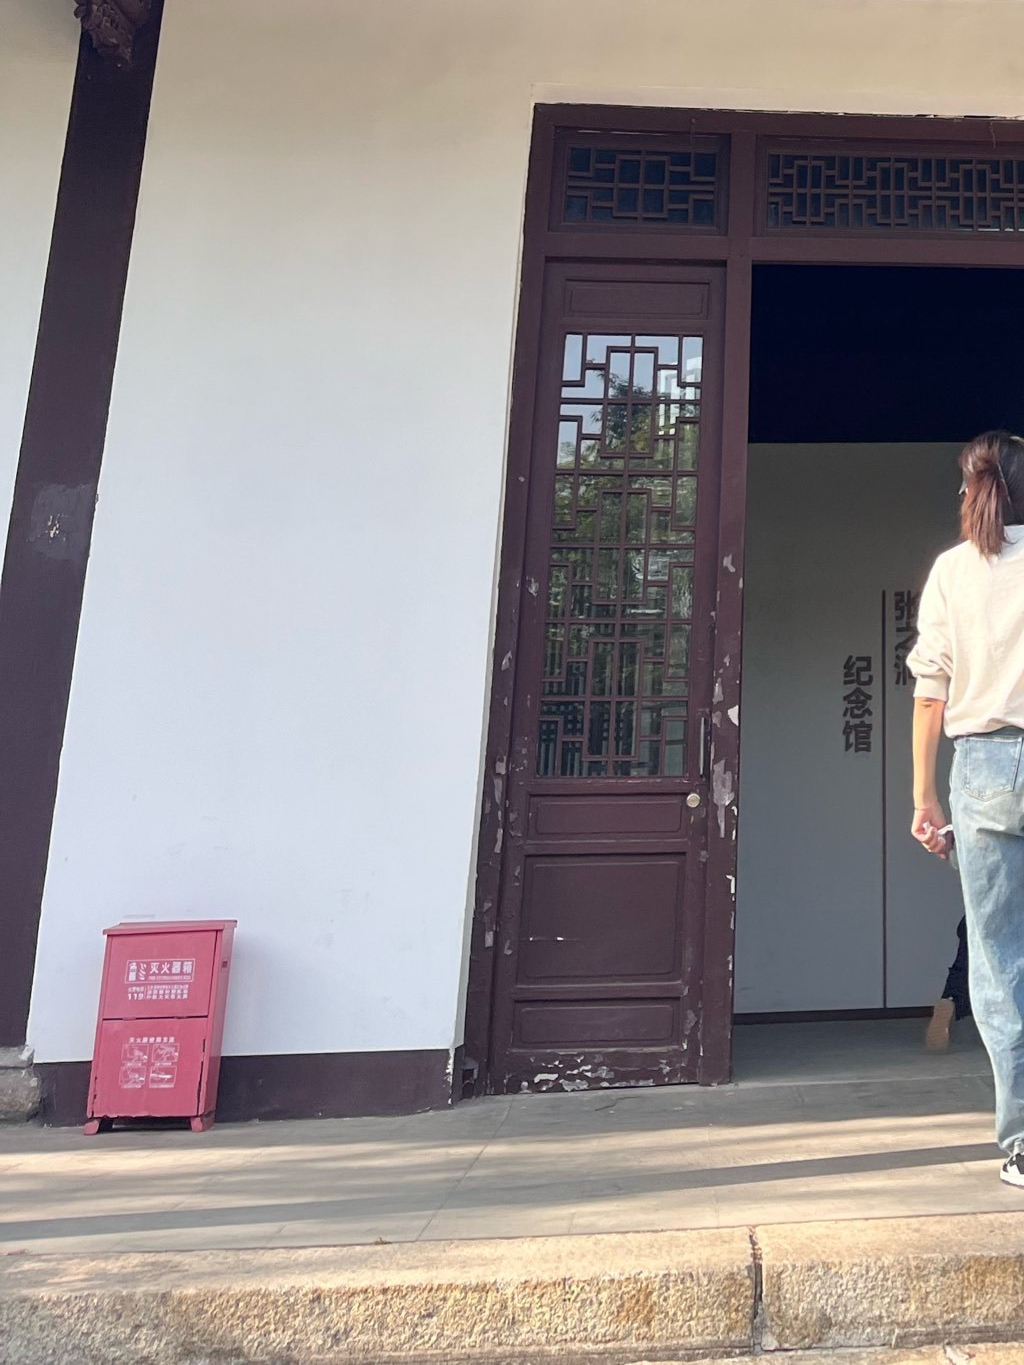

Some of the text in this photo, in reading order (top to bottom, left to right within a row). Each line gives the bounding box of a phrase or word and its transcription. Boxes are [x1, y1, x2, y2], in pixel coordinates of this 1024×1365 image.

[842, 655, 874, 753] 纪念馆
[149, 961, 193, 974] 灭火器箱
